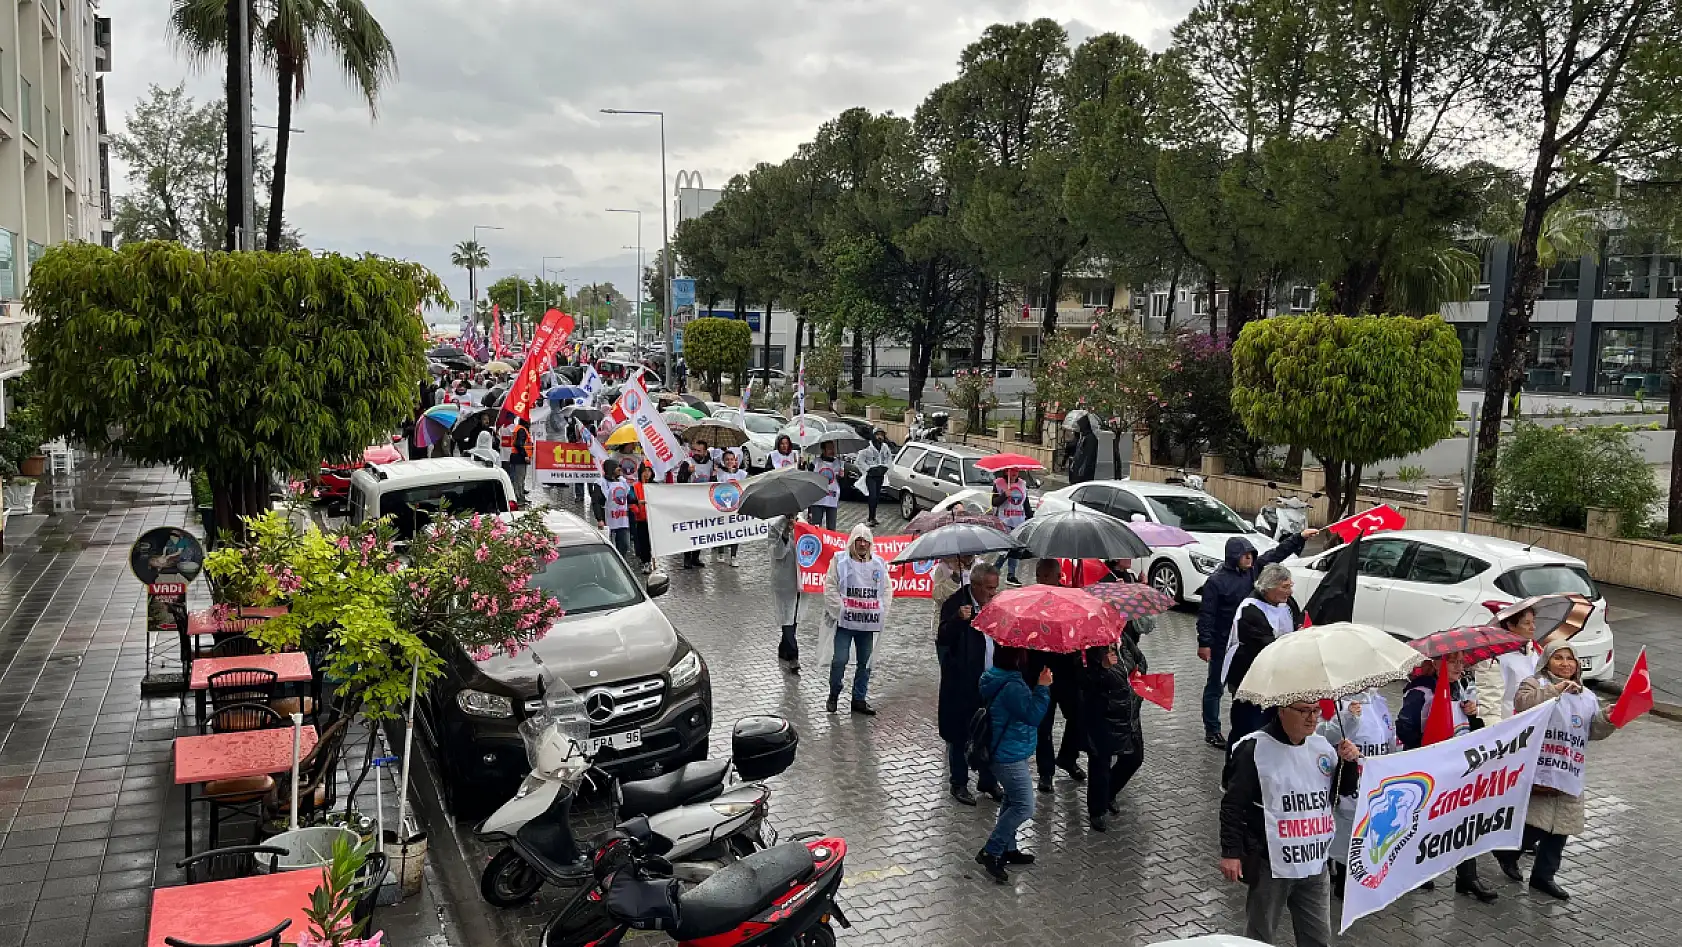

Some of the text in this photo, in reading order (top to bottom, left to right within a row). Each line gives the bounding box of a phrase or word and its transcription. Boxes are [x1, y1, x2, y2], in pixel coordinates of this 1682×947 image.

[672, 515, 725, 533] FETHİYE
[690, 522, 768, 546] TEMSİLCİLİĞ
[626, 731, 639, 743] 96
[1281, 787, 1330, 812] BİRLEŞİ
